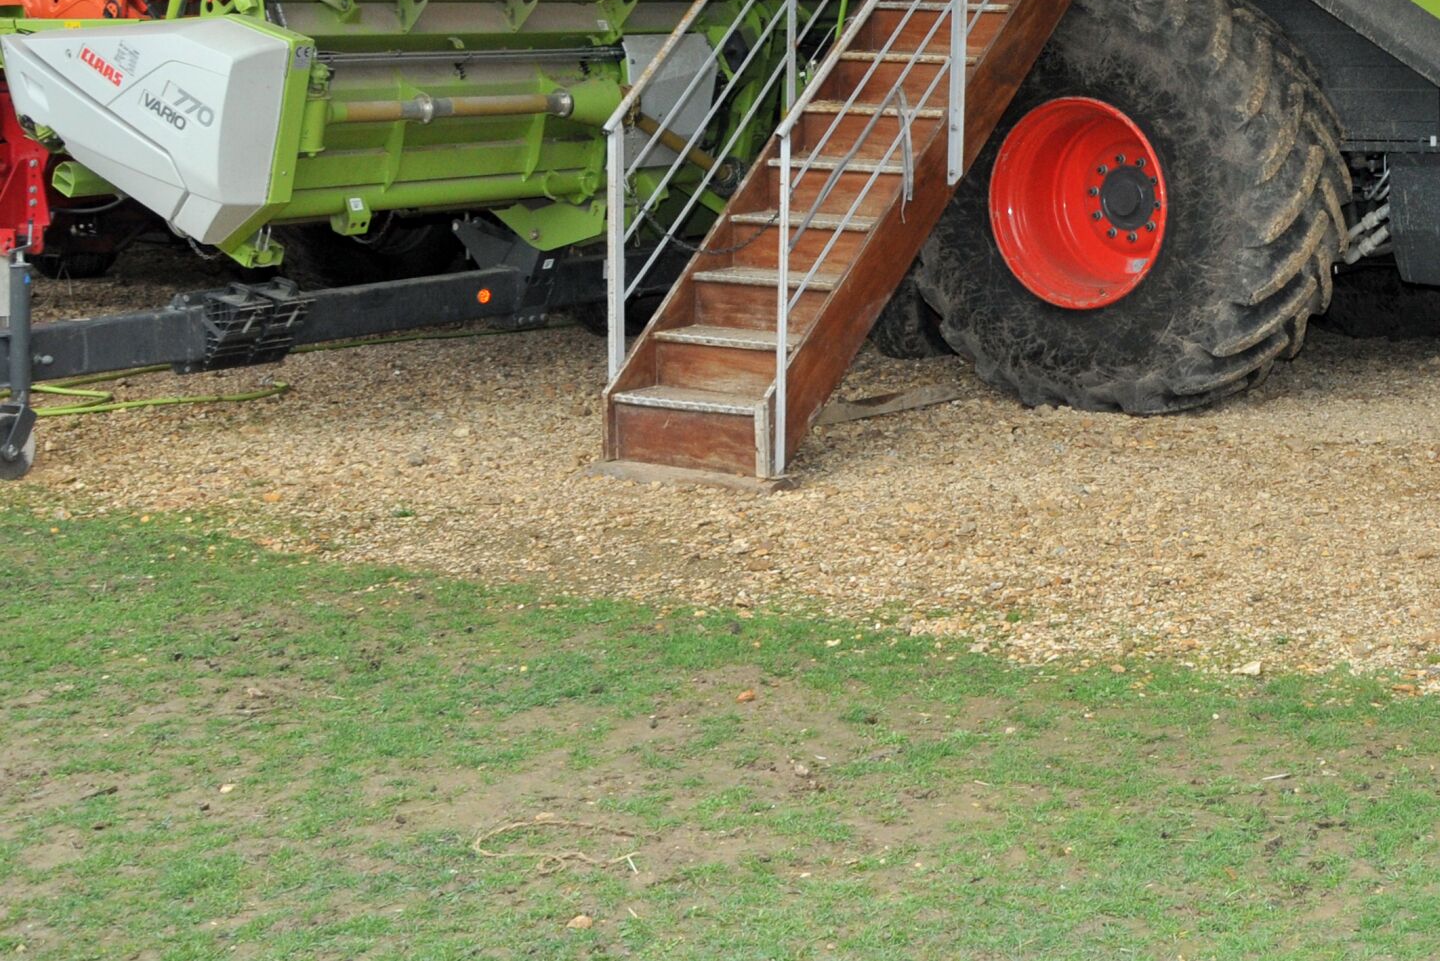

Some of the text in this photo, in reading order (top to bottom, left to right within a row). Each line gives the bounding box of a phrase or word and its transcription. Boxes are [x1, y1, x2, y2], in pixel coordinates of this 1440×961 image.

[80, 47, 124, 88] CLAAS
[144, 92, 187, 131] VARIO
[173, 87, 215, 128] 770
